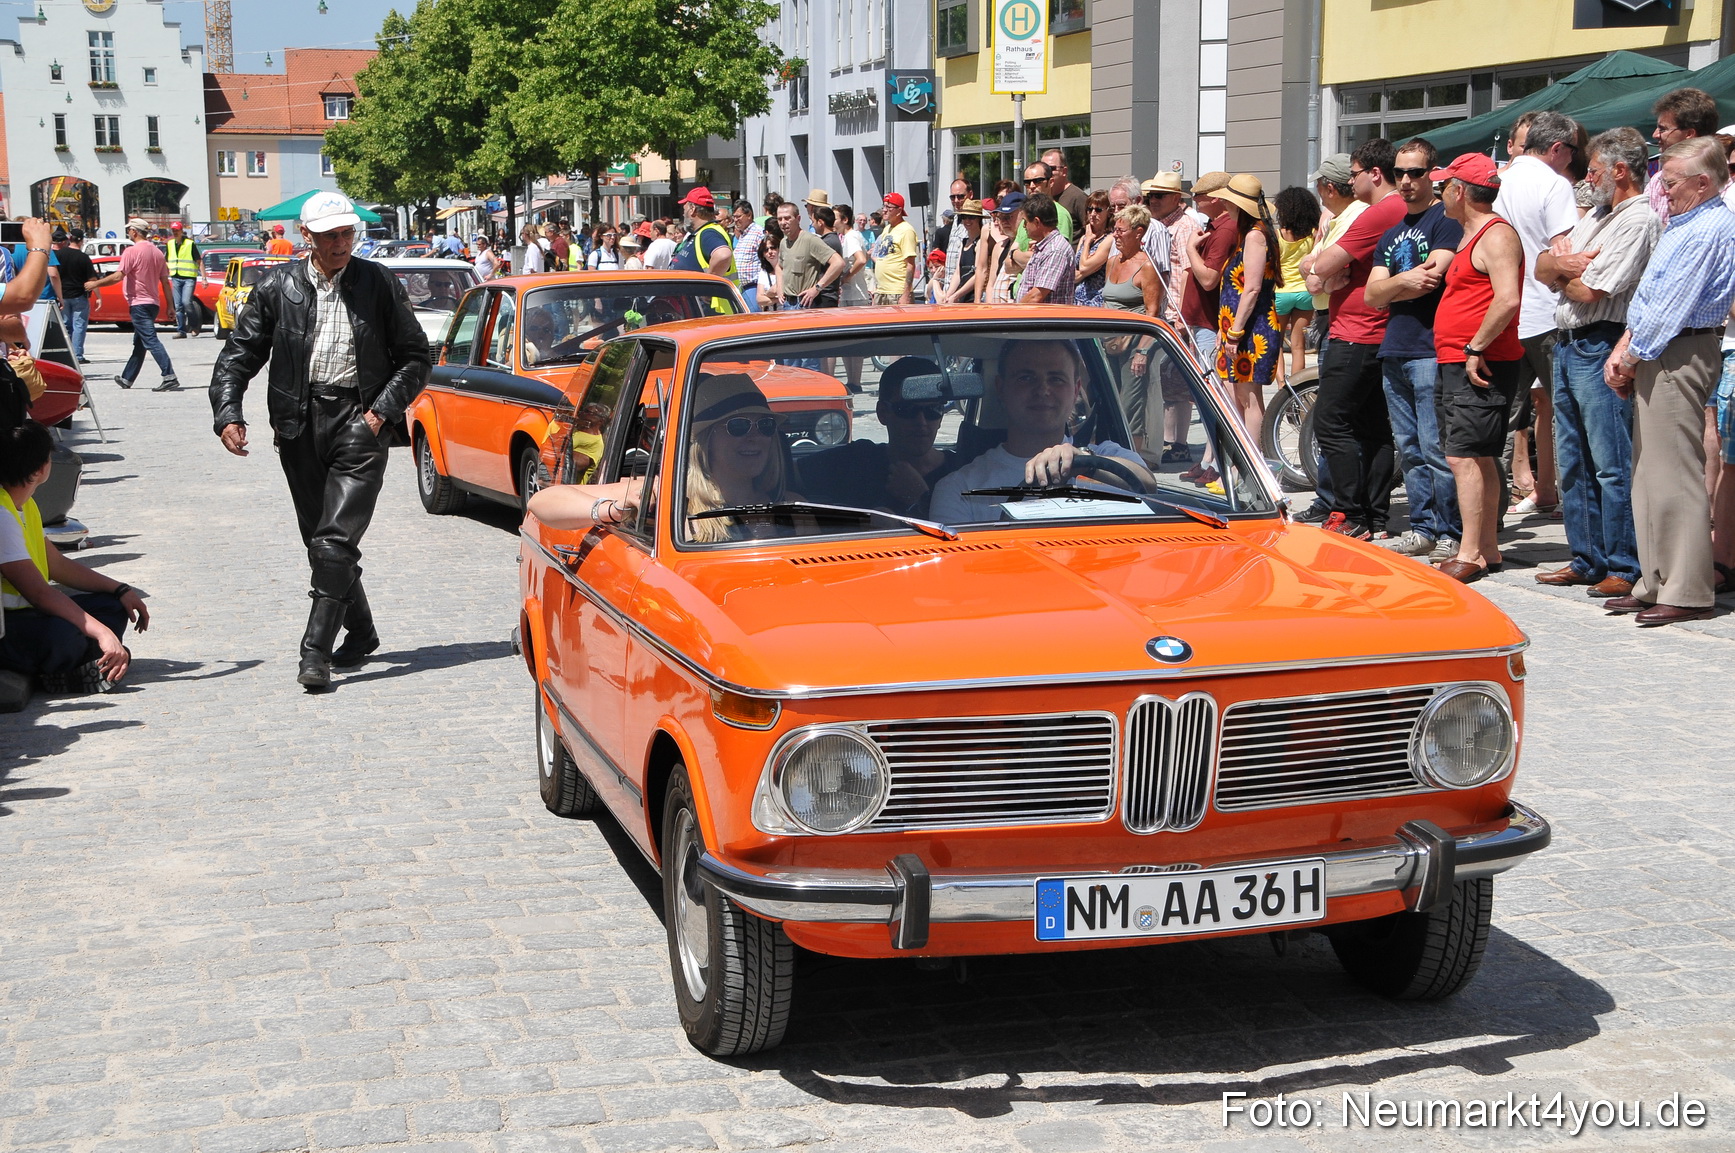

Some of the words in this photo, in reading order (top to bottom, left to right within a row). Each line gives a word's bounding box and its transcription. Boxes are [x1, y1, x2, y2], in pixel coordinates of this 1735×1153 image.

[1011, 7, 1029, 31] H
[1005, 45, 1033, 53] Rathaus
[903, 83, 921, 105] G2
[1066, 883, 1130, 931] NM
[1161, 879, 1221, 926] AA
[1045, 916, 1056, 929] D
